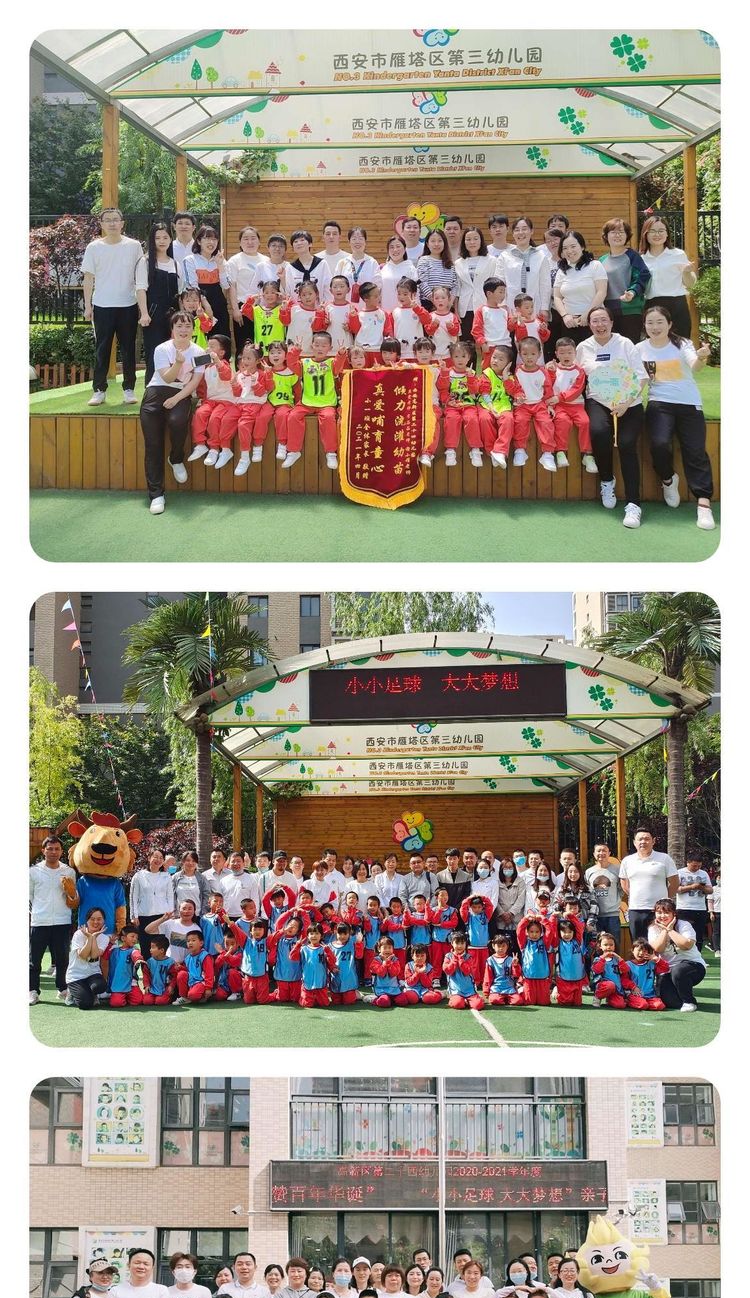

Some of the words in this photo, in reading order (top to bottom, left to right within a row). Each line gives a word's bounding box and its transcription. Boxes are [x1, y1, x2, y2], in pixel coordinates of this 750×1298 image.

[333, 47, 542, 70] 西安市雁塔区第三幼儿园
[362, 71, 431, 81] Kindergarten
[433, 70, 460, 78] Yanta
[462, 68, 496, 77] District
[523, 66, 542, 76] City
[352, 116, 509, 130] 西安市雁塔区第三幼儿园
[359, 153, 486, 166] 西安市雁塔区第三幼儿园
[261, 325, 273, 336] 27
[312, 376, 326, 396] 11
[346, 674, 422, 695] 小小足球
[441, 672, 520, 692] 大大梦想
[366, 734, 484, 746] 西安市雁塔区第三幼儿园
[369, 761, 468, 770] 西安市雁塔区第三幼儿园
[340, 951, 352, 961] 27
